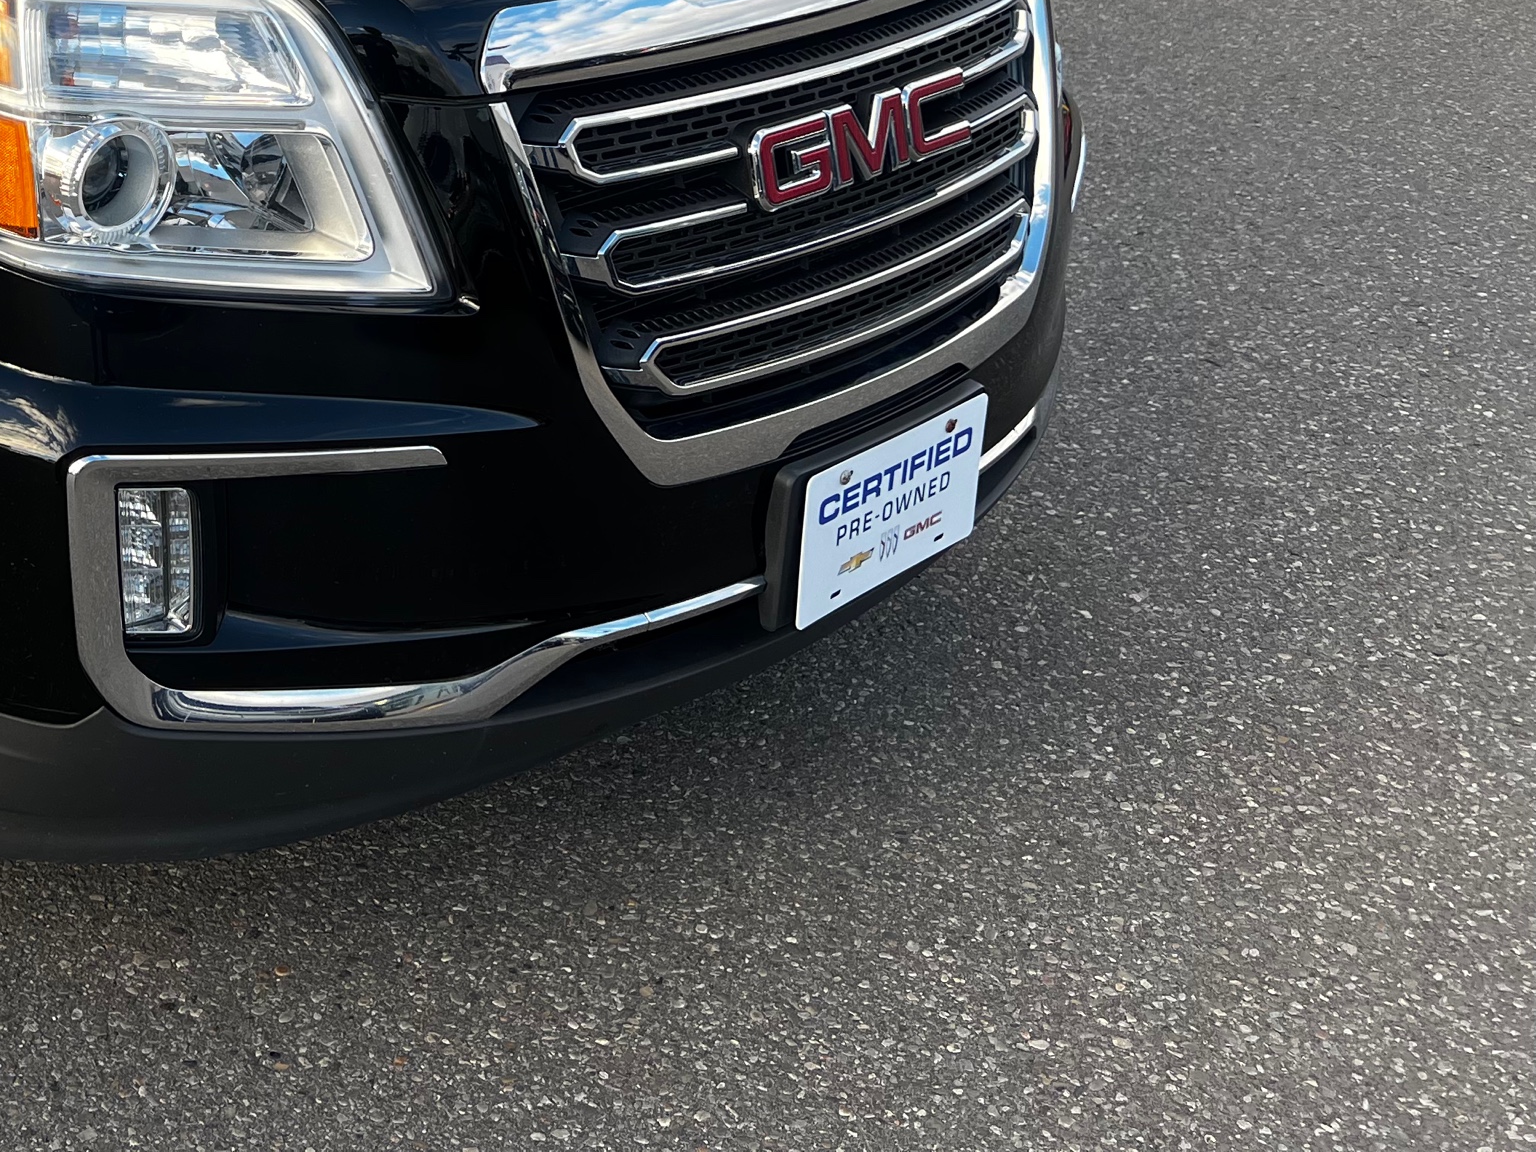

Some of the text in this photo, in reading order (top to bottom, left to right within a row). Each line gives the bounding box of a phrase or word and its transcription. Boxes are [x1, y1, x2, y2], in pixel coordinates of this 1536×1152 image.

[748, 66, 972, 212] GMC
[818, 426, 973, 526] CERTIFIED
[836, 470, 951, 547] PRE-OWNED
[903, 510, 943, 541] GMC
